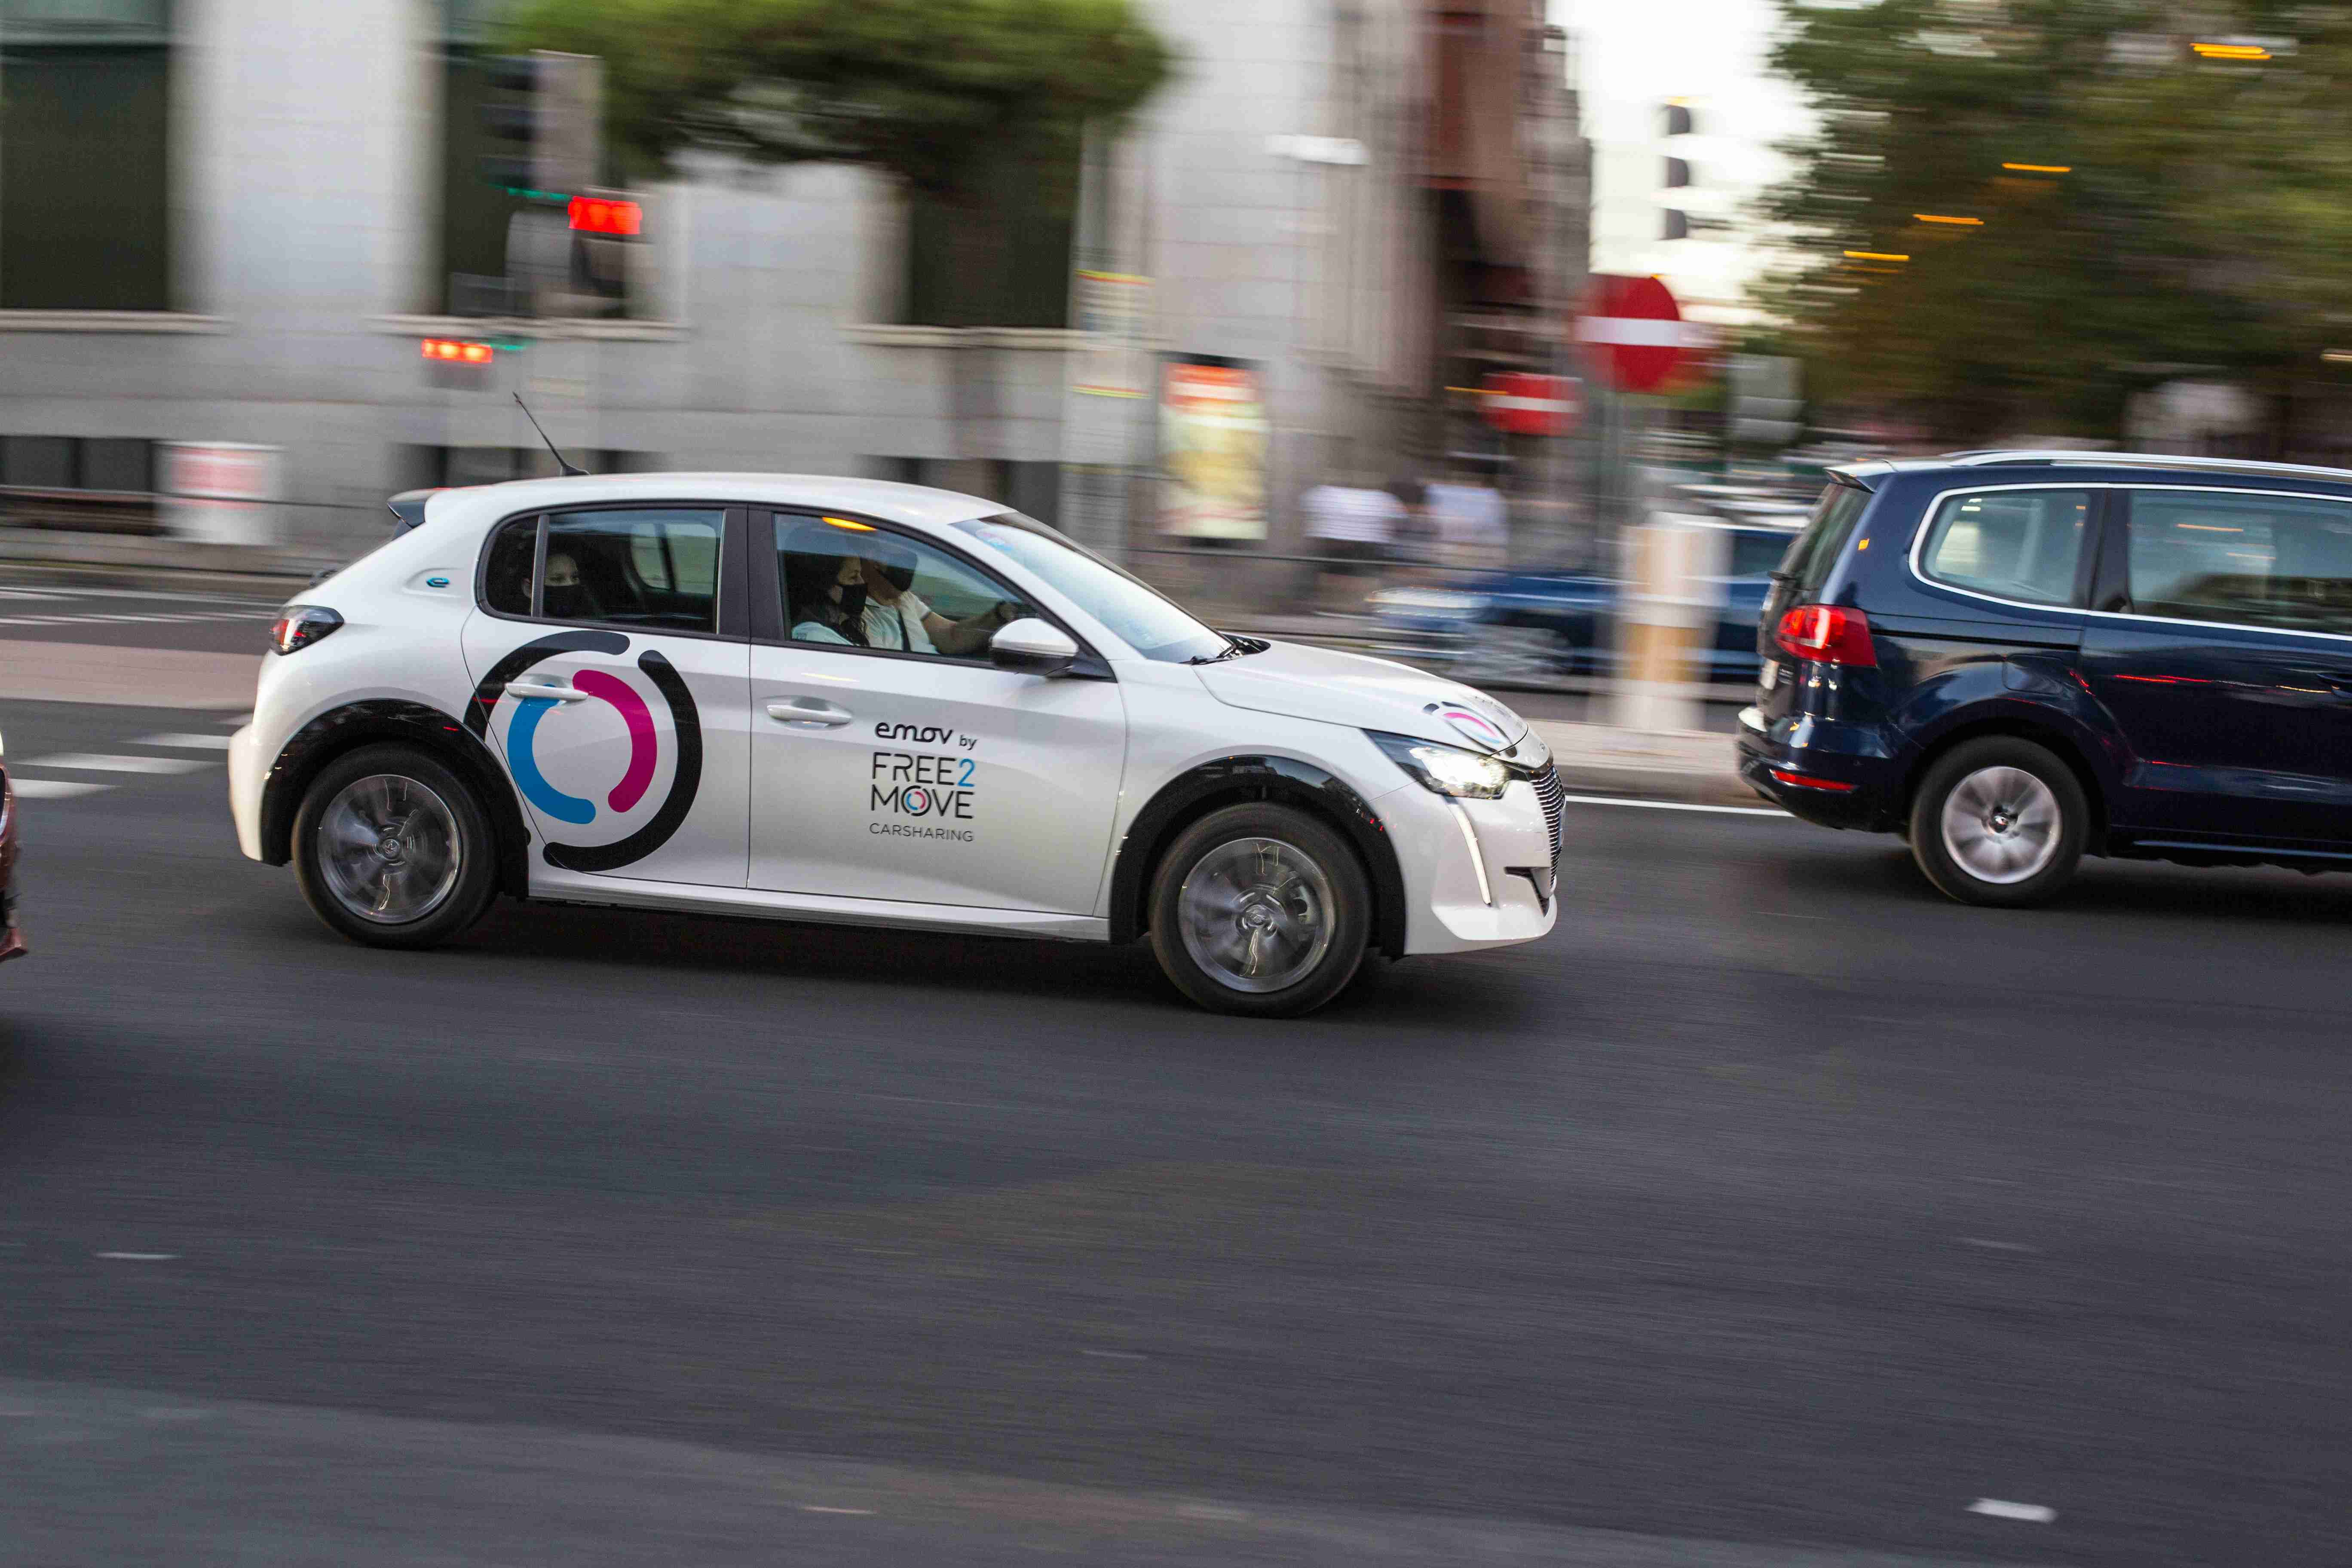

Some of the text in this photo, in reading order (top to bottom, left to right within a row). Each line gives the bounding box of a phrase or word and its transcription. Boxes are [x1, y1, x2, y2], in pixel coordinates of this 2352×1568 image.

[875, 722, 977, 750] emov by
[872, 752, 976, 787] FREE2
[871, 784, 974, 819] MOVE
[869, 823, 974, 842] CARSHARING
